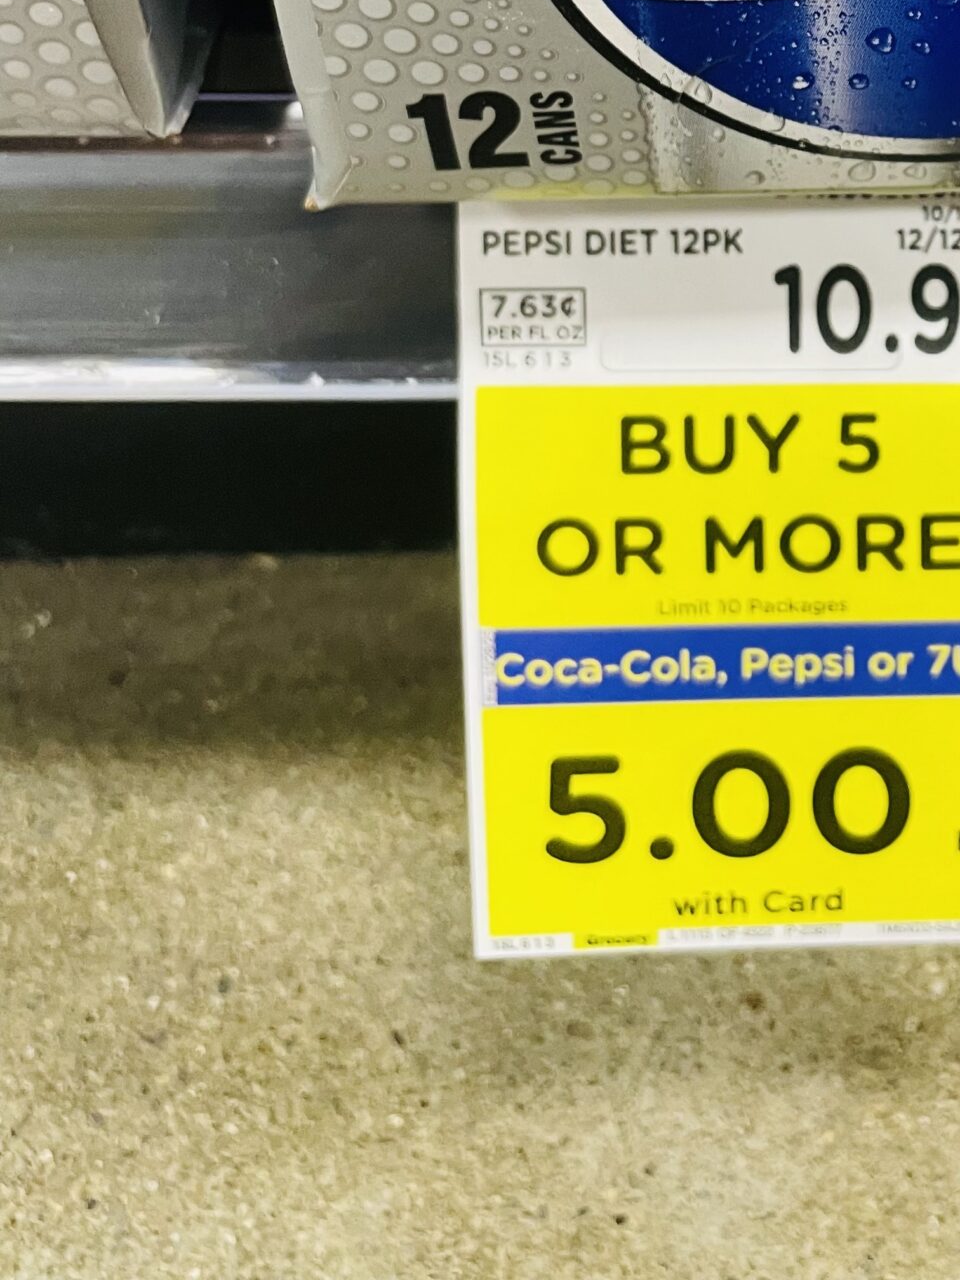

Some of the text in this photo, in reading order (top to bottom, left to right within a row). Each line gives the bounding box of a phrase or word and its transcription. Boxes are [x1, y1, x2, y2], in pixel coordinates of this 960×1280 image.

[406, 90, 582, 171] 12 CANS
[482, 228, 743, 256] PEPSI DIET 12PK
[490, 293, 577, 319] 7.63¢
[487, 325, 584, 340] PER FL OZ
[619, 413, 880, 475] BUY 5
[536, 518, 663, 577] OR
[658, 598, 849, 617] Limit 10 Packages
[495, 647, 728, 687] Coca-Cola,
[741, 645, 855, 685] Pepsi
[868, 650, 914, 677] or
[545, 746, 911, 864] 5.00
[674, 888, 845, 917] with Card
